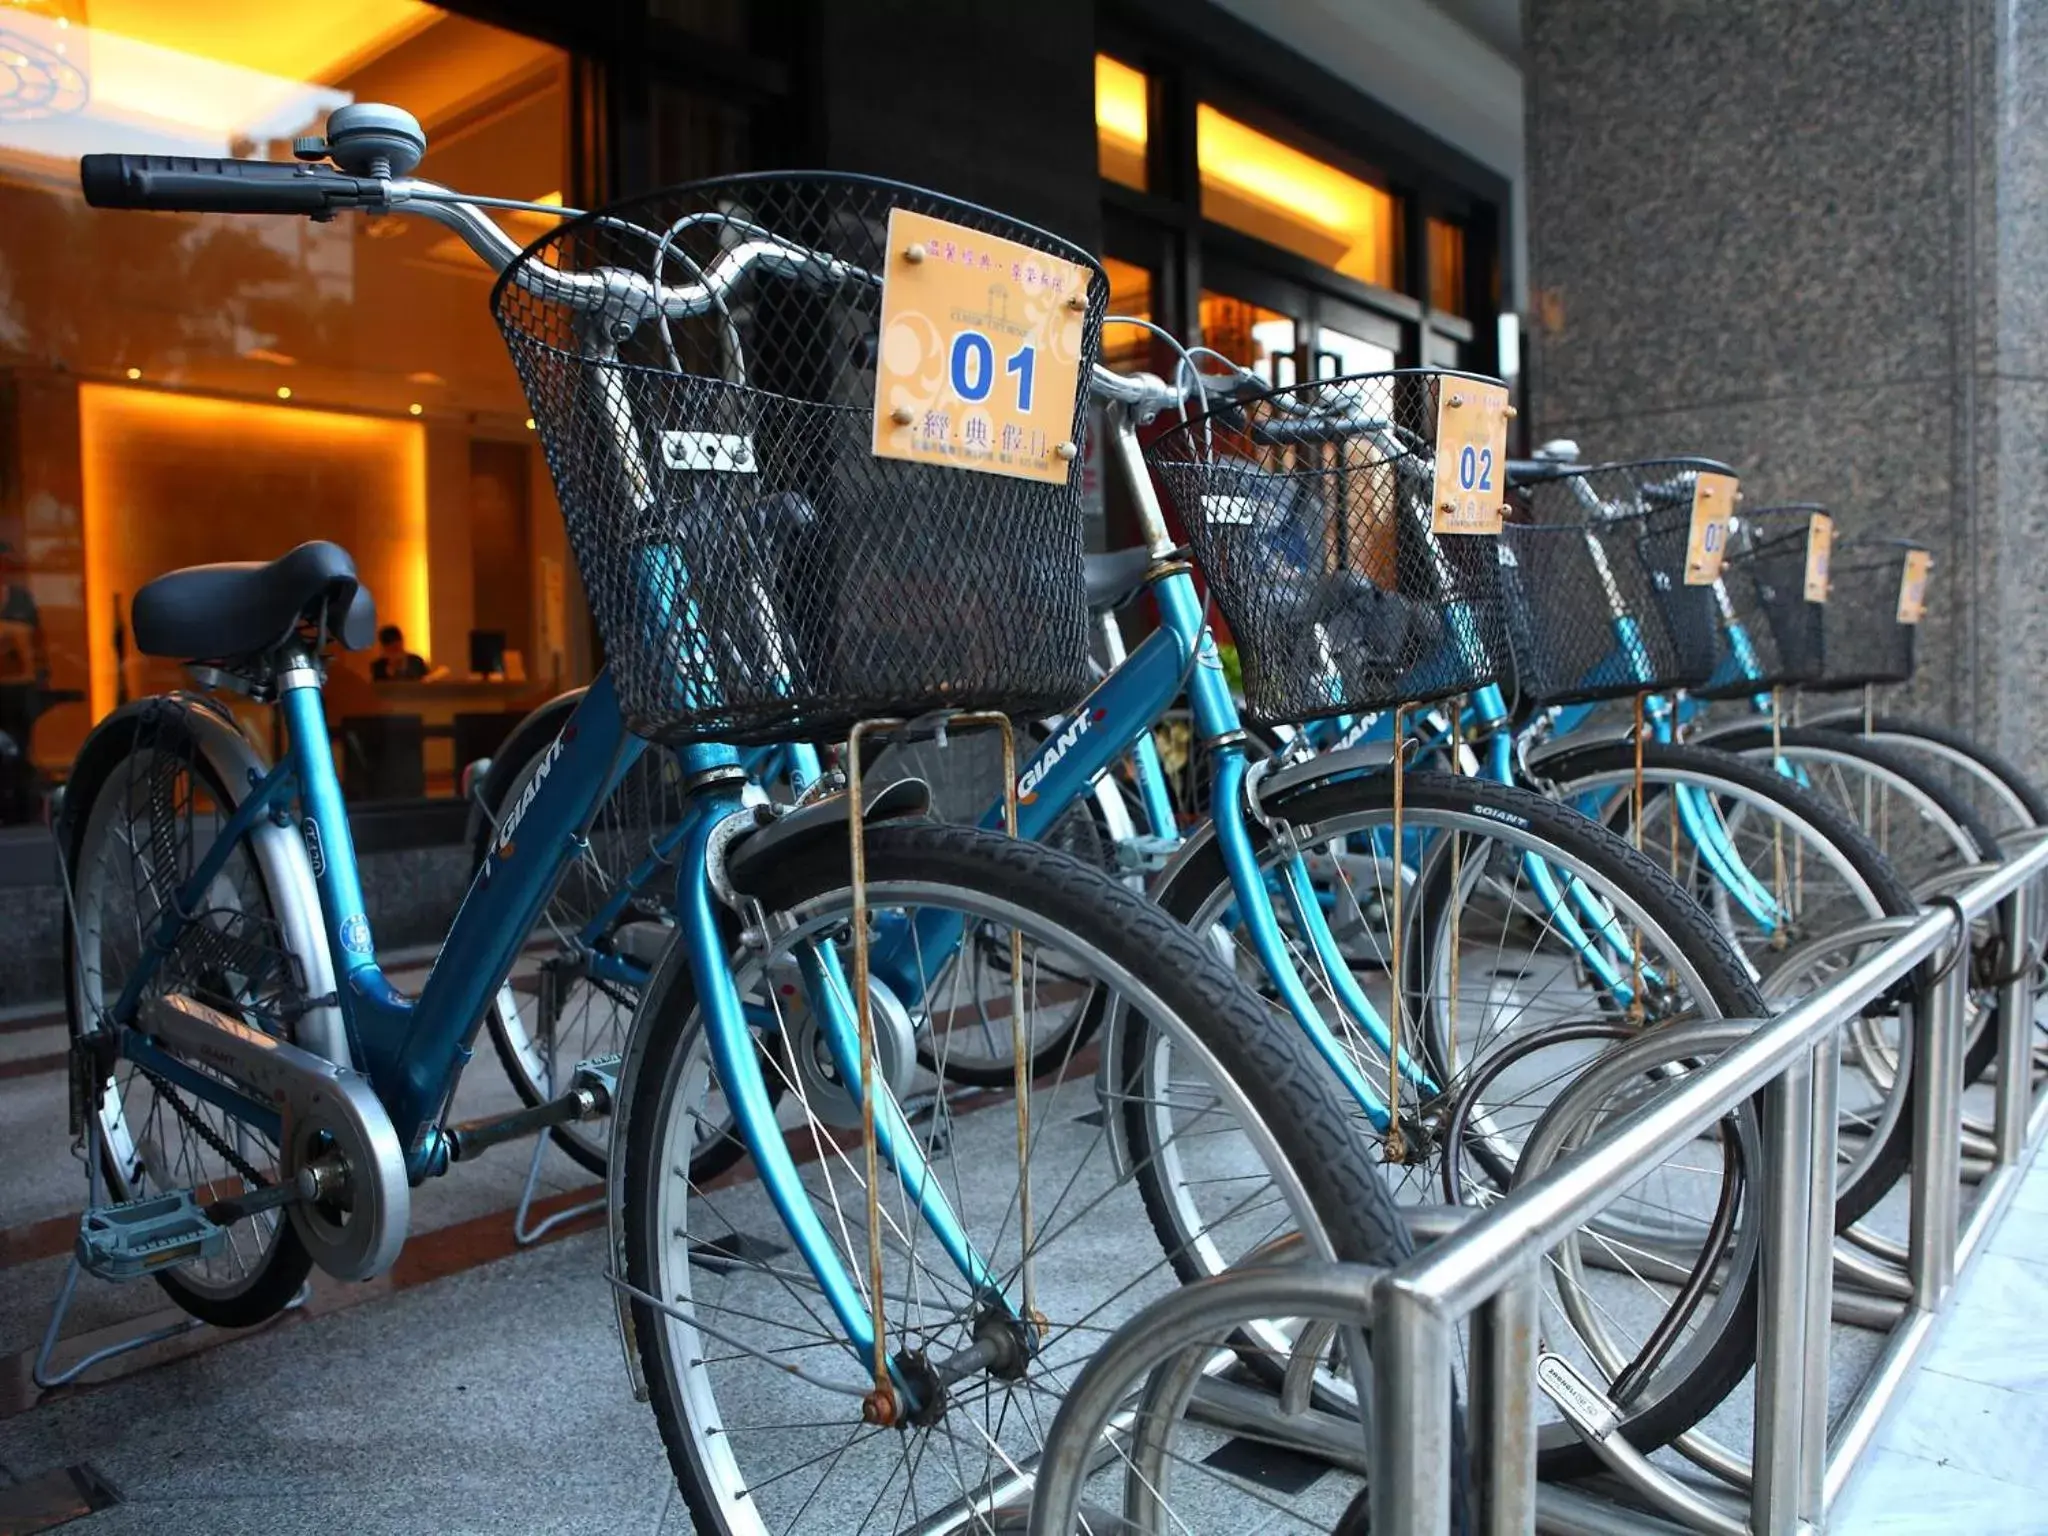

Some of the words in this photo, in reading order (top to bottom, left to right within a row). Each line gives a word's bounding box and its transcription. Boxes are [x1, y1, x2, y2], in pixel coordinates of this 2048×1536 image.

[950, 331, 1036, 413] 01
[1459, 445, 1493, 491] 02
[500, 738, 564, 849] GIANT
[1017, 707, 1092, 800] GIANT
